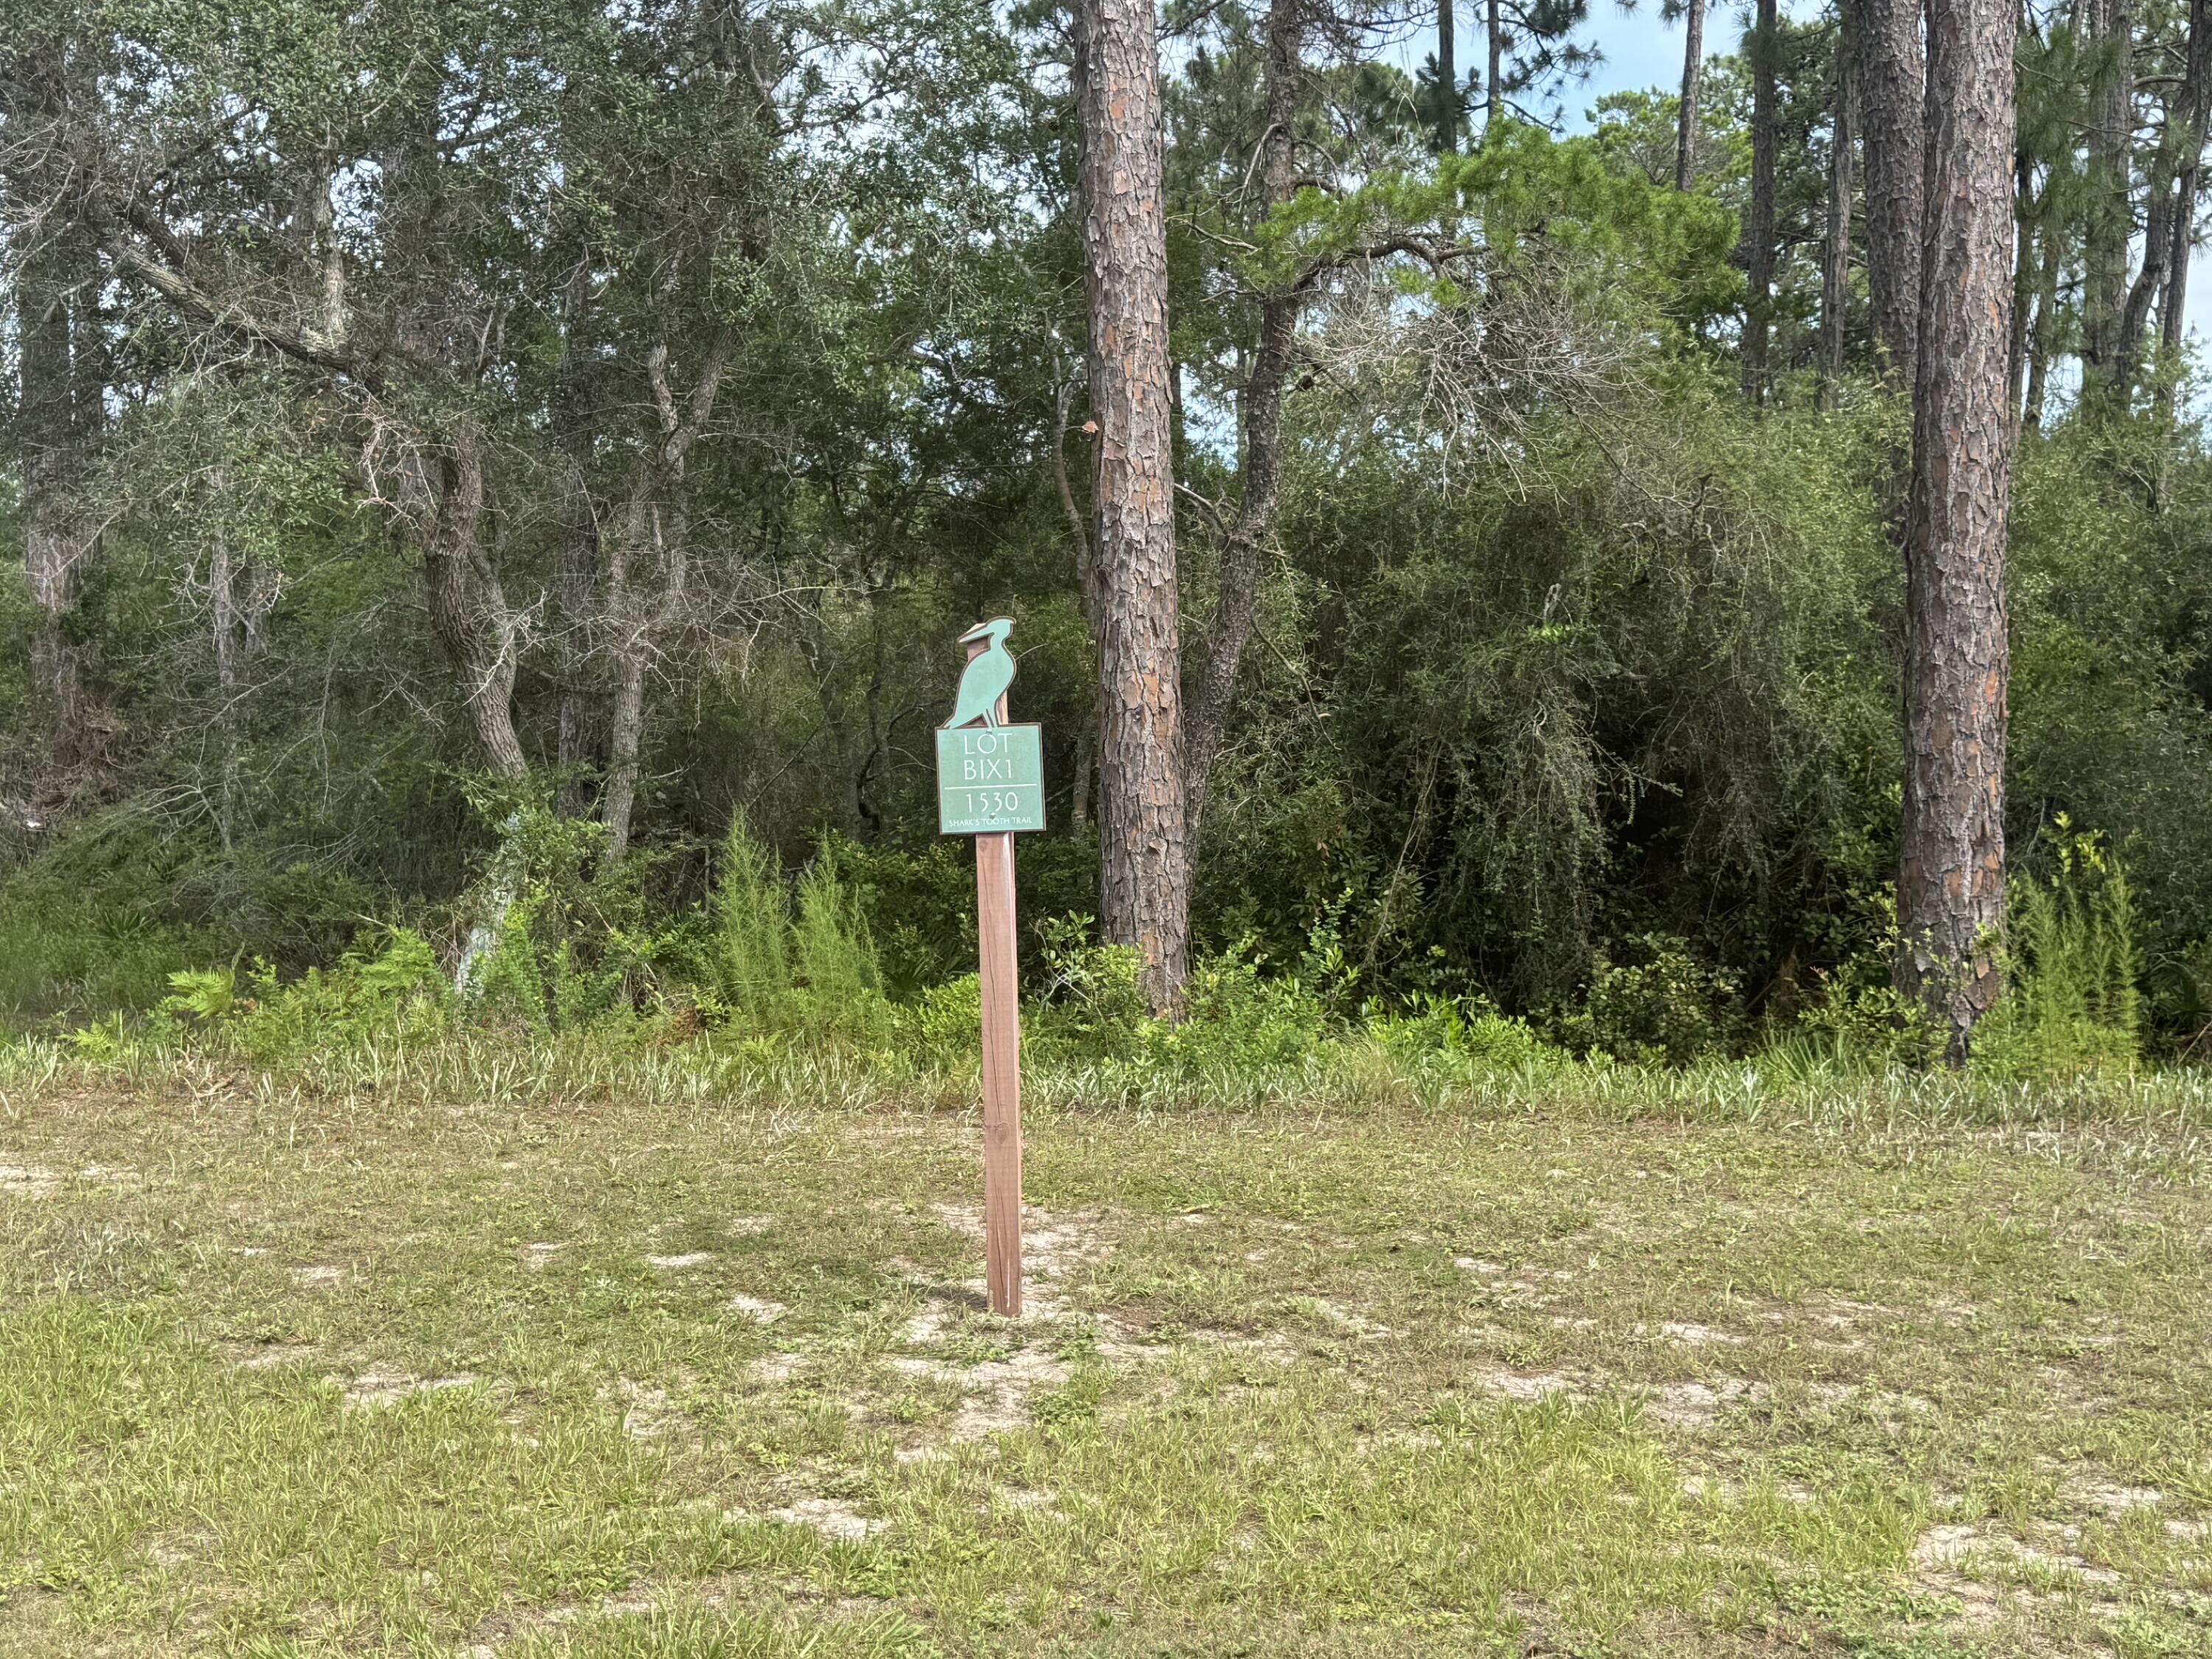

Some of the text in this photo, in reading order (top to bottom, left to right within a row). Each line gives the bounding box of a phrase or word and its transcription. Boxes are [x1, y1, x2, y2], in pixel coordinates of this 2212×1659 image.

[964, 733, 1013, 755] LOT
[965, 792, 1018, 813] 1530
[982, 817, 1010, 826] TOOTH
[1012, 816, 1032, 824] TRAIL
